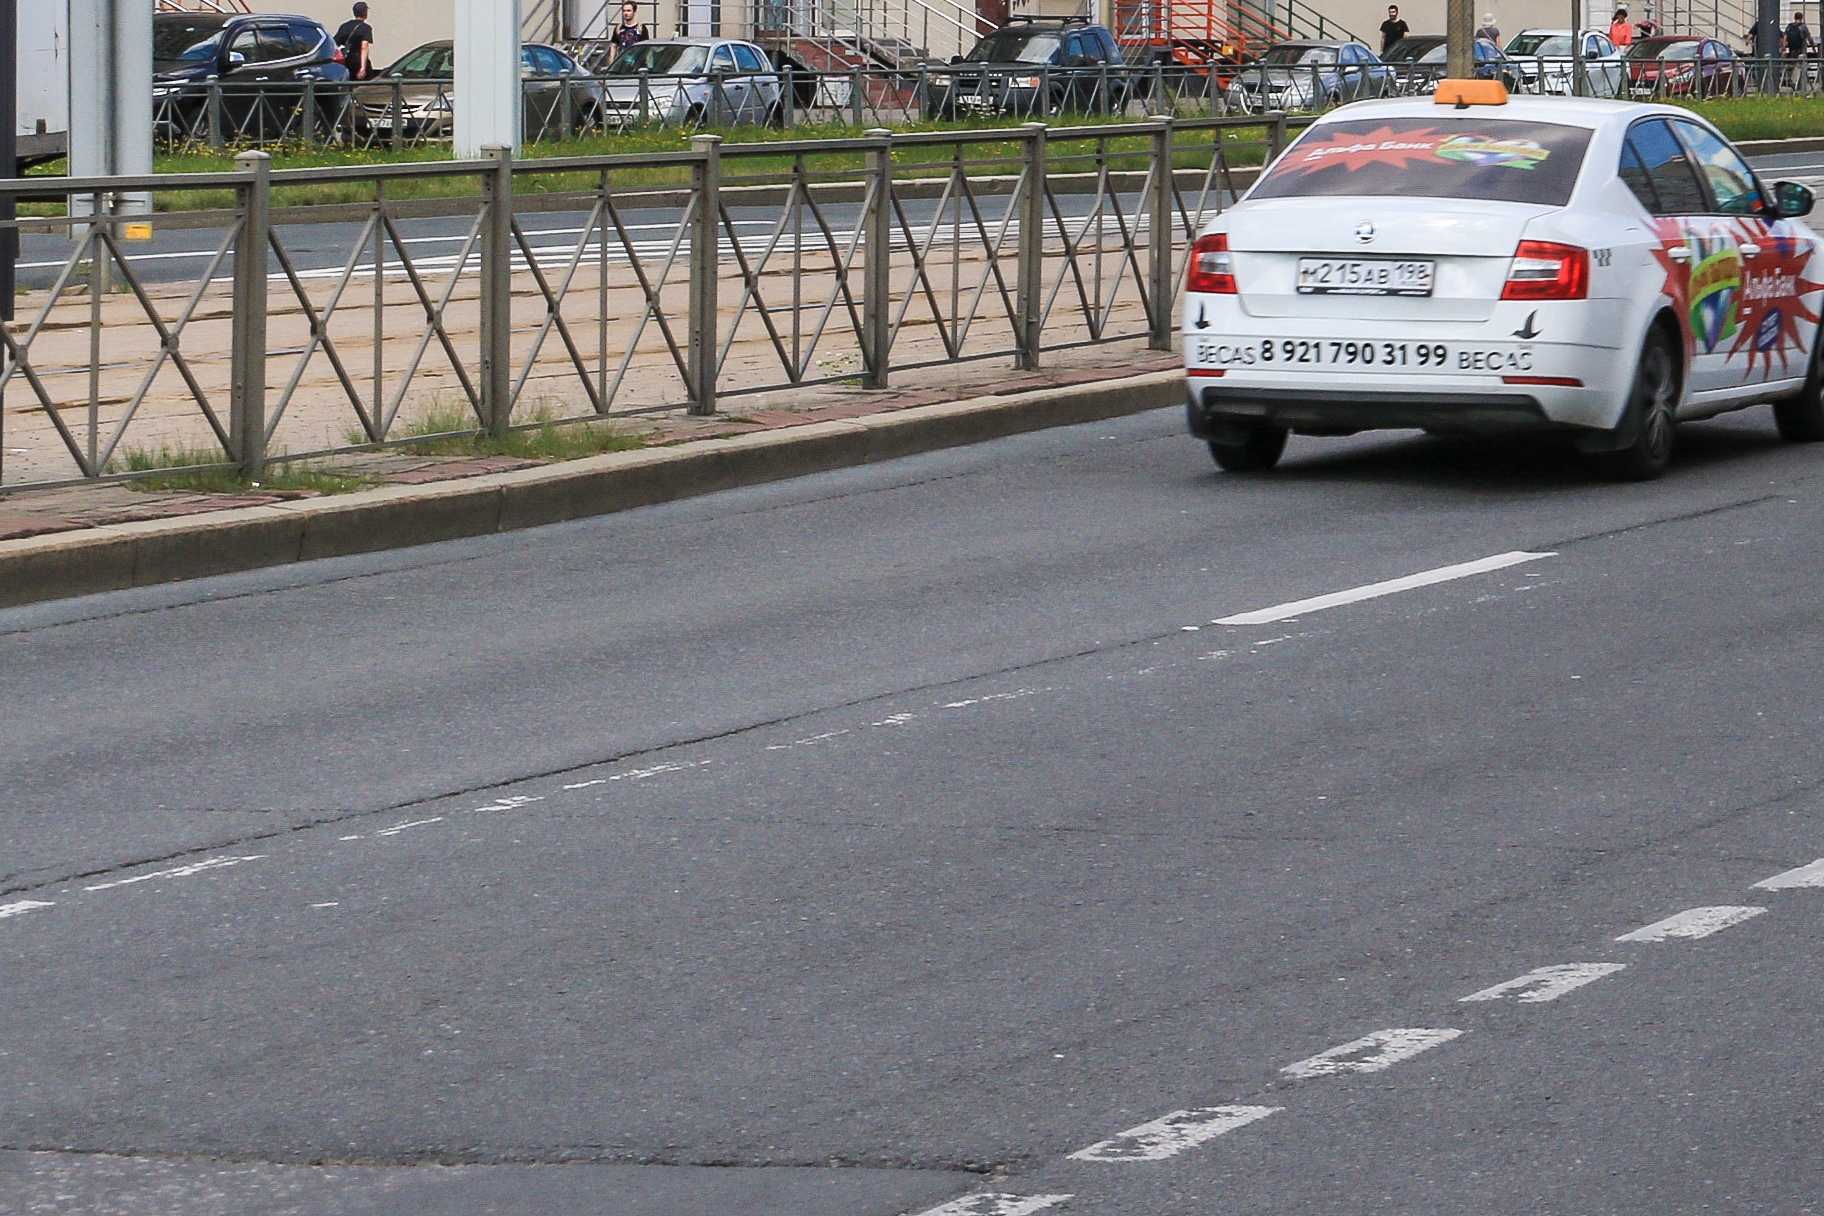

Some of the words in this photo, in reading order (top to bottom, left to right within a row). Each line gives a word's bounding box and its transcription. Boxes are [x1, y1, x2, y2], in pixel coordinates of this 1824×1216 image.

[1379, 140, 1434, 150] Банк
[1395, 263, 1430, 280] 198
[1260, 339, 1275, 362] 8
[1282, 340, 1322, 363] 921
[1329, 341, 1375, 365] 790
[1381, 343, 1408, 366] 31
[1416, 344, 1447, 367] 99
